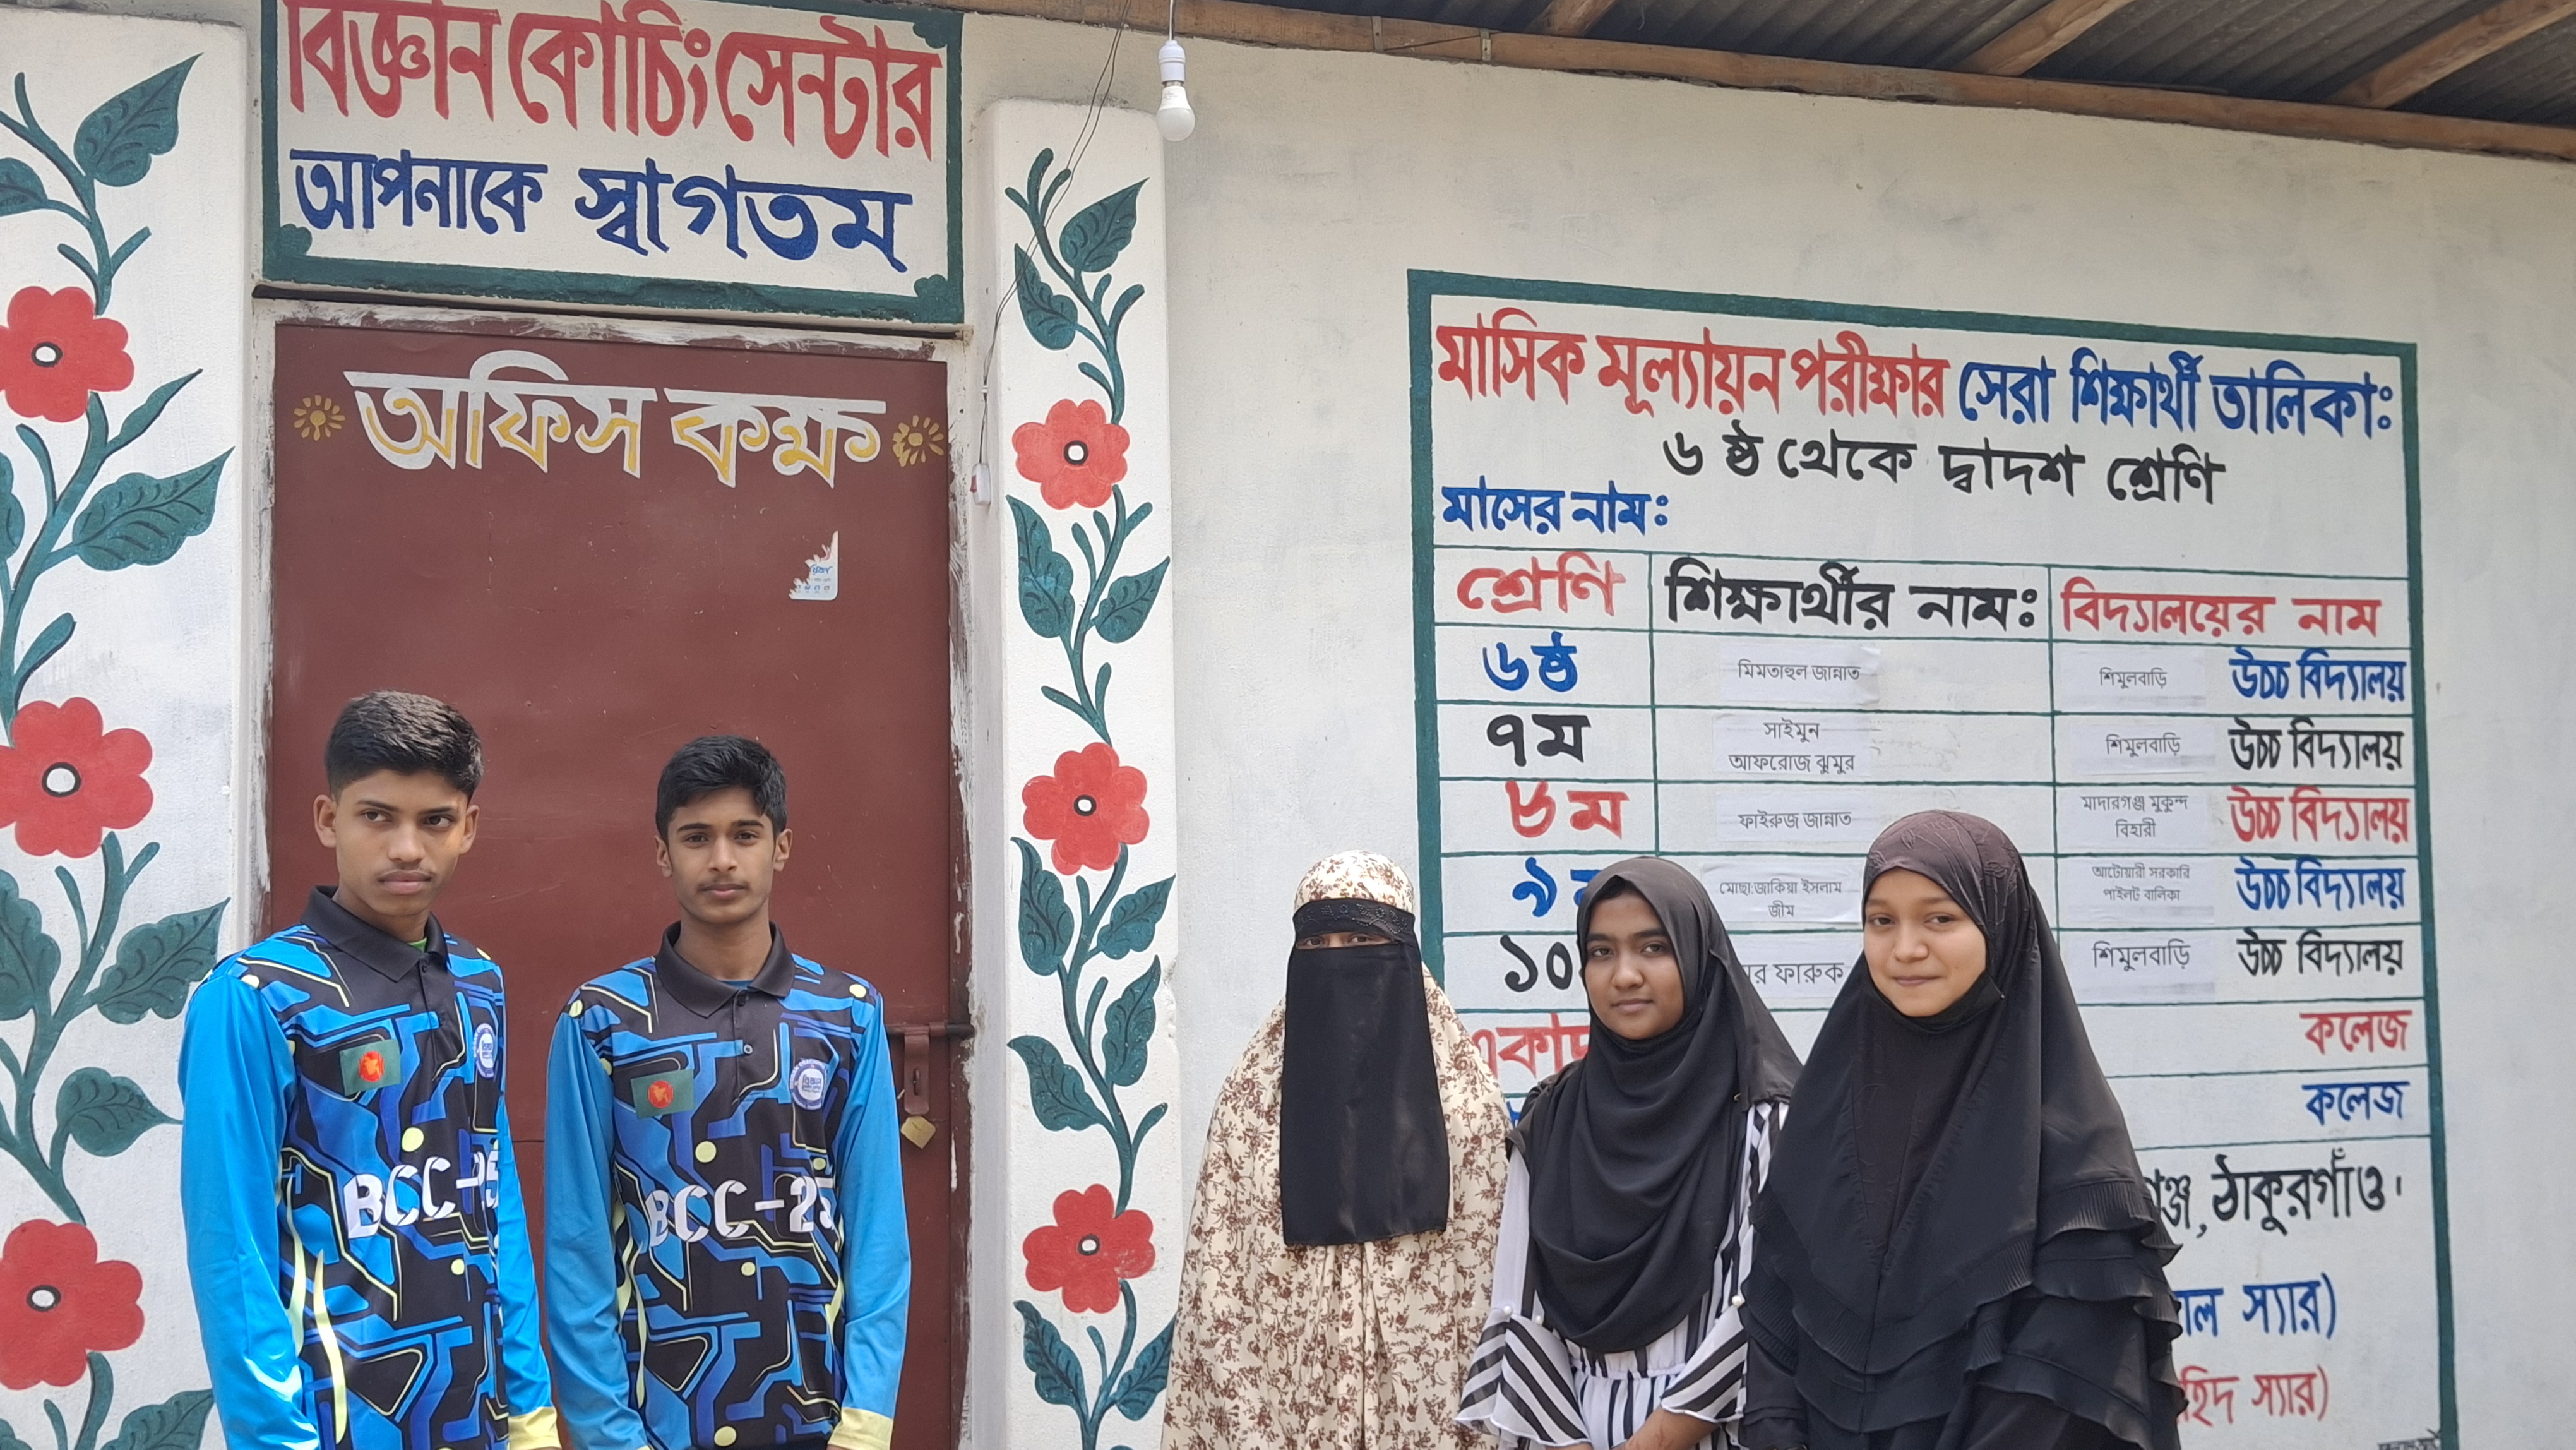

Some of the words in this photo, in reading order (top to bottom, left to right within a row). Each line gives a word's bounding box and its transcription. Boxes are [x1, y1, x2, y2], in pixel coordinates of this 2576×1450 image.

[283, 0, 502, 121] বিজ্ঞান
[508, 0, 712, 137] কোচিং
[715, 15, 943, 162] সেন্টার
[290, 149, 548, 235] আপনাকে
[575, 158, 913, 273] স্বাগতম
[1435, 306, 1588, 405] মাসিক
[1595, 326, 1787, 418] মূল্যায়ন
[1790, 330, 1952, 418] পরীক্ষার
[1959, 355, 2057, 425] সেরা
[2068, 347, 2204, 433] শিক্ষার্থী
[343, 349, 659, 479] অফিস
[663, 387, 886, 489] কক্ষ
[1777, 428, 1918, 484] থেকে
[1937, 436, 2086, 498] দ্বাদশ
[2106, 443, 2227, 505] শ্রেণি
[1441, 475, 1566, 535] মাসের
[1457, 548, 1626, 617] শ্রেণি
[1664, 556, 1896, 630] শিক্ষার্থীর
[2060, 575, 2277, 637] বিদ্যালয়ের
[2291, 598, 2383, 637] নাম
[1811, 665, 1861, 681] জান্নাত
[2099, 666, 2168, 690] শিমুলবাড়ি
[2227, 645, 2291, 700] উচ্চ
[2296, 647, 2407, 702] বিদ্যালয়
[1763, 717, 1820, 743] সাইমুন
[2105, 732, 2181, 758] শিমুলবাড়ি
[2227, 716, 2283, 771] উচ্চ
[2288, 716, 2405, 771] বিদ্যালয়
[1728, 754, 1811, 773] আফরোজ
[1815, 755, 1856, 775] ঝুমুর
[1737, 808, 1799, 830] ফাইরুজ
[1802, 812, 1852, 829] জান্নাত
[2080, 795, 2145, 813] মাদারগঞ্জ
[2149, 795, 2189, 813] মুকুন্দ
[2227, 784, 2285, 842] উচ্চ
[2289, 783, 2411, 844] বিদ্যালয়
[2115, 817, 2157, 838] বিহারী
[1800, 878, 1842, 894] ইসলাম
[2102, 885, 2140, 901] পাইলট
[2143, 885, 2181, 901] বালিকা
[2148, 863, 2190, 879] সরকারি
[2233, 855, 2291, 911] উচ্চ
[2294, 856, 2406, 911] বিদ্যালয়
[1768, 899, 1795, 918] জীম
[1772, 962, 1845, 985] ফারুক
[2092, 938, 2191, 972] শিমুলবাড়ি
[2236, 927, 2287, 976] উচ্চ
[2295, 928, 2404, 977] বিদ্যালয়
[2299, 1010, 2413, 1055] কলেজ
[2301, 1081, 2411, 1126] কলেজ
